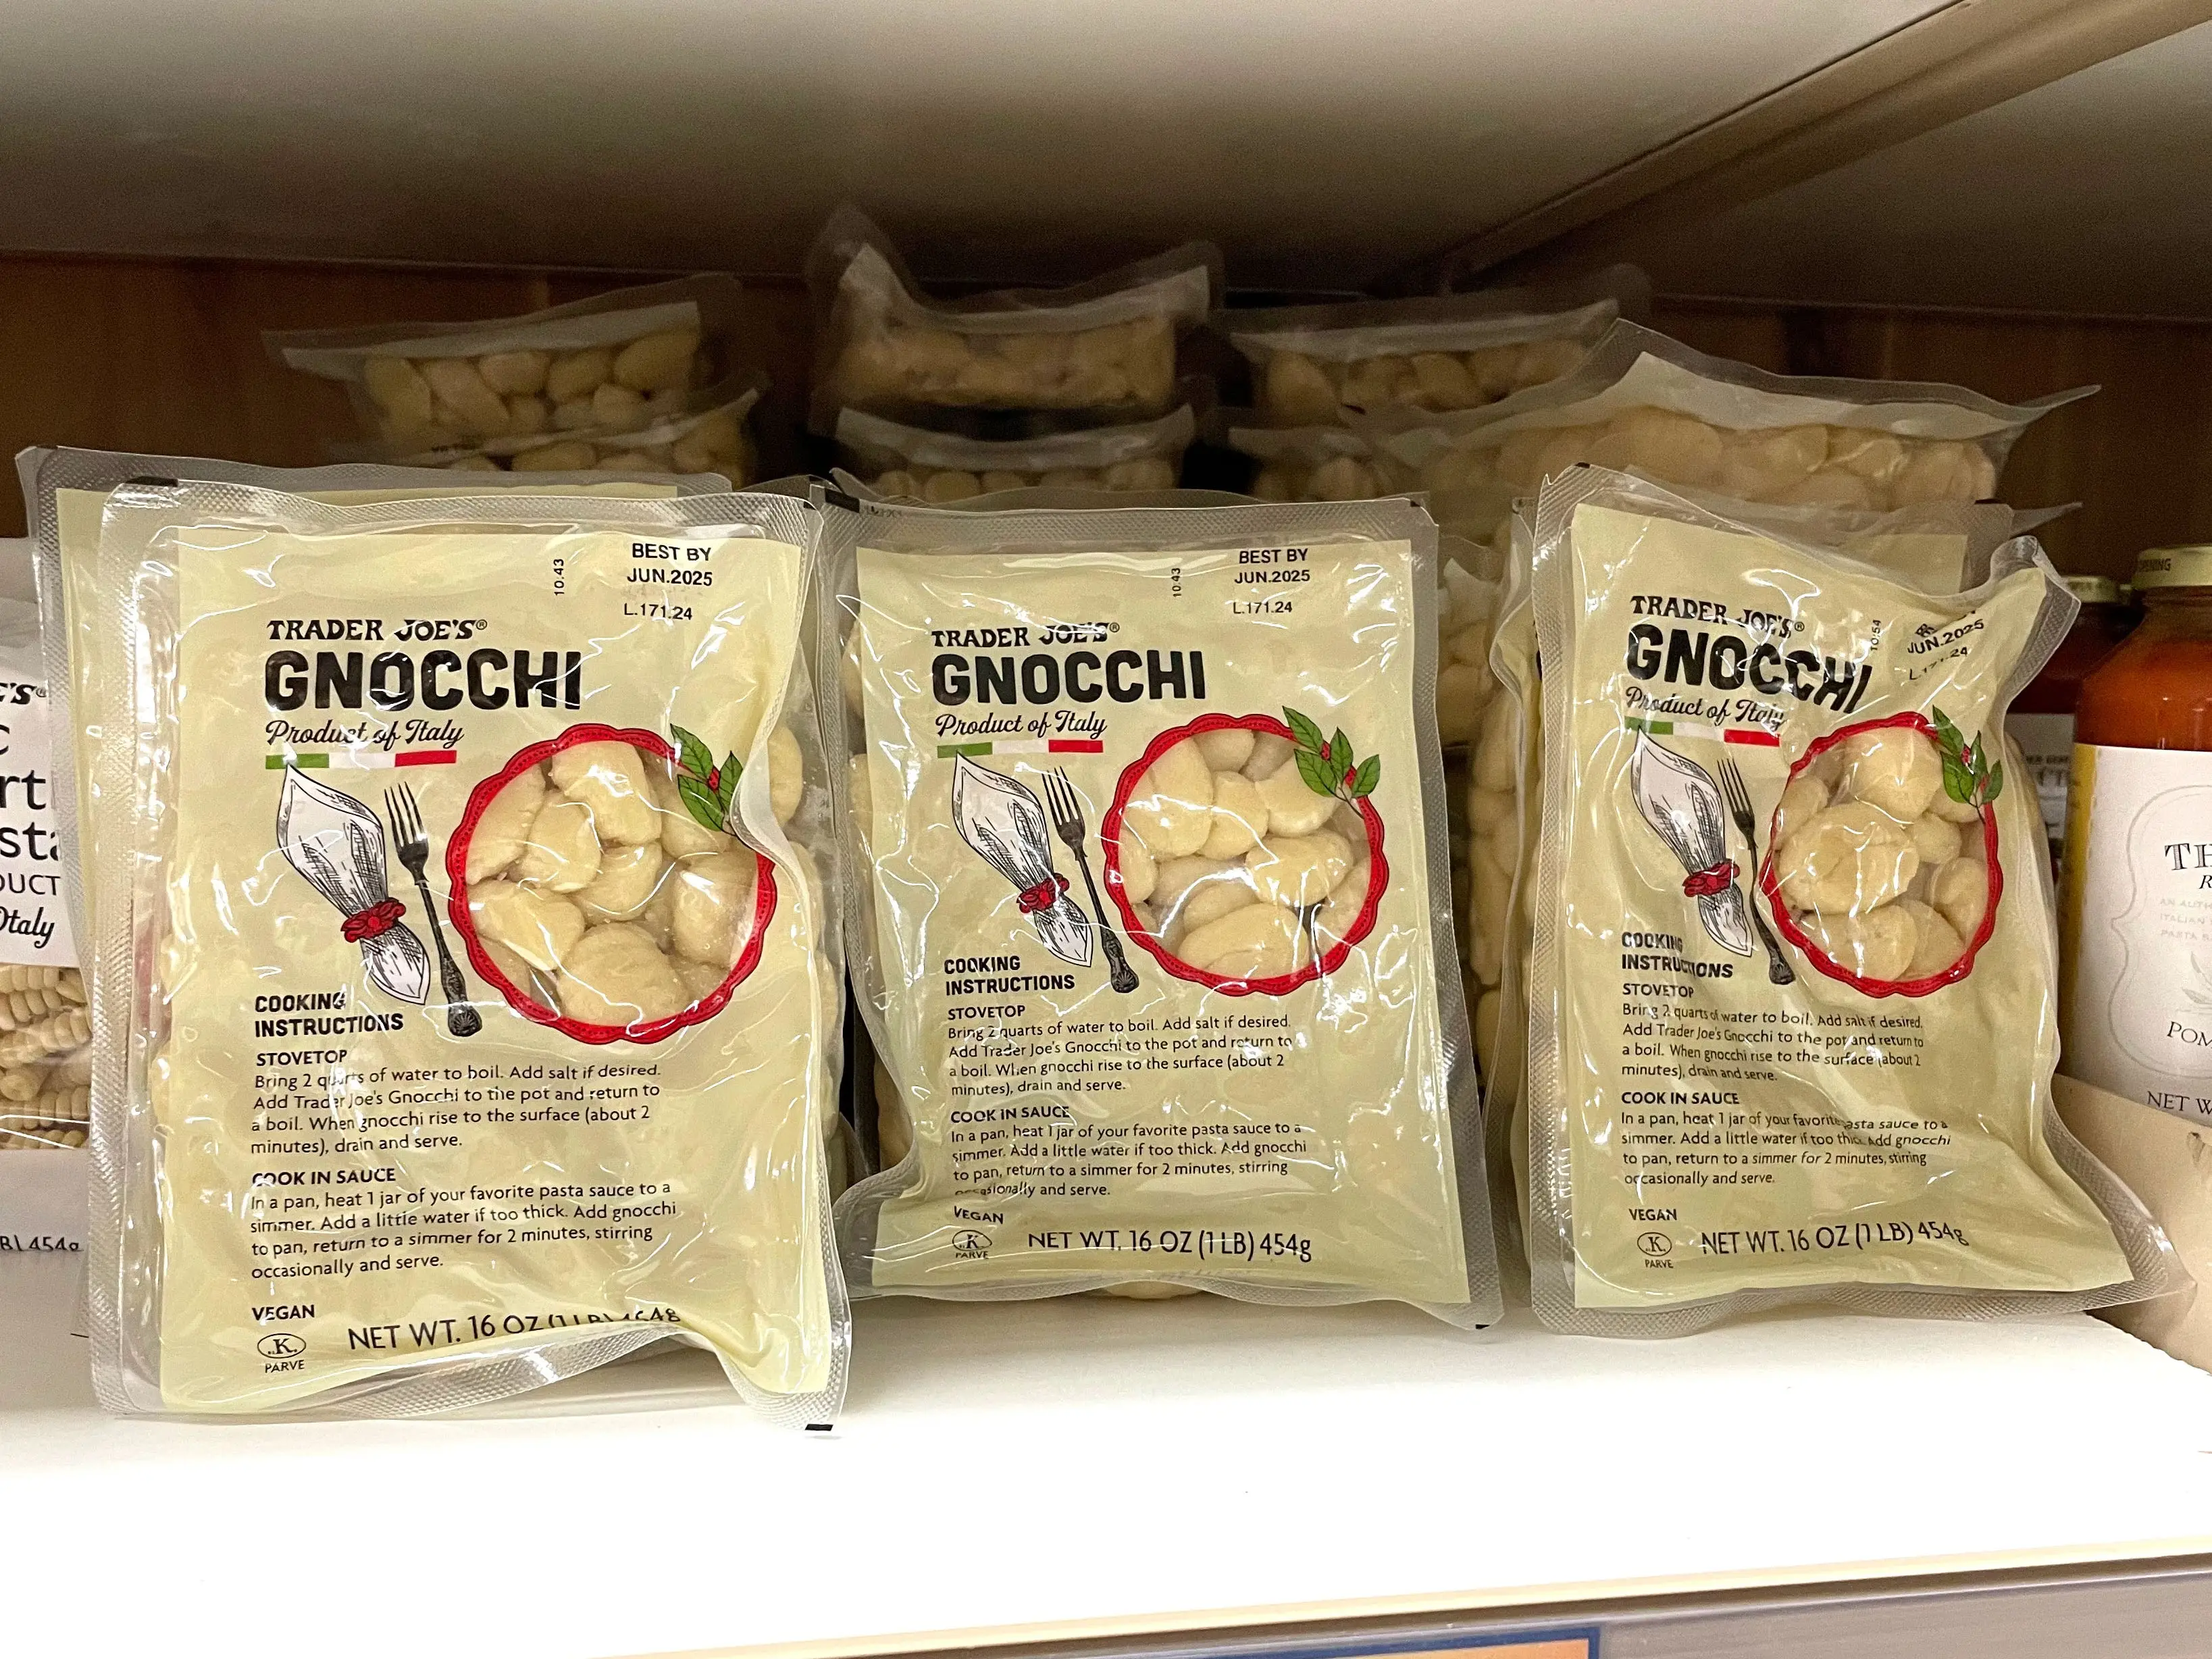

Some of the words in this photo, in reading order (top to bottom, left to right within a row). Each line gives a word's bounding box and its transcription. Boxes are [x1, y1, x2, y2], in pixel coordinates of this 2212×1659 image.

[632, 543, 680, 560] BEST
[686, 547, 711, 561] BY
[1239, 550, 1281, 564] BEST
[1287, 548, 1309, 562] BY
[627, 568, 713, 586] JUN.2025
[1234, 569, 1310, 584] JUN.2025
[623, 603, 692, 620] L.171.24
[1233, 601, 1293, 615] L.171.24
[1630, 595, 1728, 626] TRADER
[267, 619, 384, 641] TRADER
[931, 626, 1031, 648] TRADER
[1907, 619, 1984, 653] JUN.2025
[932, 649, 1206, 706] GNOCCHI
[1626, 623, 1873, 714] GNOCCHI
[265, 648, 581, 711] GNOCCHI
[1626, 686, 1703, 716] Product
[1706, 699, 1730, 725] of
[935, 711, 1023, 737] Product
[1028, 712, 1051, 737] of
[1054, 710, 1108, 737] Italy
[265, 719, 367, 745] Product
[373, 720, 401, 751] of
[405, 719, 465, 749] Italy
[1622, 932, 1682, 953] COOKING
[944, 955, 1021, 975] COOKING
[1622, 954, 1734, 978] INSTRUCTIONS
[946, 975, 1075, 996] INSTRUCTIONS
[1622, 983, 1694, 999] STOVETOP
[255, 992, 346, 1013] COOKING
[948, 1005, 1025, 1020] STOVETOP
[255, 1013, 404, 1038] INSTRUCTIONS
[948, 1027, 983, 1041] Bring
[988, 1026, 996, 1038] 2
[1000, 1024, 1042, 1039] quarts
[1048, 1021, 1062, 1034] of
[1067, 1022, 1104, 1033] water
[1109, 1021, 1124, 1032] to
[1128, 1019, 1159, 1031] boil.
[1162, 1017, 1191, 1030] Add
[1195, 1017, 1219, 1029] salt
[1224, 1015, 1235, 1028] if
[1238, 1014, 1291, 1028] desired.
[257, 1050, 347, 1067] STOVETOP
[1622, 1092, 1666, 1104] COOK
[1670, 1092, 1687, 1104] IN
[1691, 1092, 1740, 1104] SAUCE
[2147, 1090, 2190, 1111] NET
[252, 1119, 260, 1131] a
[267, 1117, 303, 1131] boil.
[309, 1115, 354, 1131] When
[360, 1111, 423, 1132] gnocchi
[430, 1111, 457, 1125] rise
[464, 1109, 481, 1123] to
[487, 1108, 514, 1122] the
[520, 1107, 580, 1121] surface
[586, 1106, 636, 1125] (about
[641, 1106, 650, 1119] 2
[951, 1109, 996, 1123] COOK
[1001, 1108, 1017, 1119] IN
[1021, 1106, 1070, 1118] SAUCE
[251, 1139, 329, 1156] minutes),
[335, 1138, 371, 1153] drain
[380, 1135, 409, 1149] and
[415, 1135, 462, 1148] serve.
[252, 1172, 305, 1187] COOK
[311, 1171, 330, 1184] IN
[336, 1169, 396, 1183] SAUCE
[1624, 1171, 1708, 1188] occasionally
[1712, 1171, 1738, 1184] and
[1741, 1174, 1775, 1185] serve.
[251, 1196, 264, 1209] In
[270, 1198, 278, 1209] a
[284, 1198, 319, 1213] pan,
[325, 1192, 362, 1206] heat
[367, 1192, 374, 1205] 1
[380, 1193, 401, 1208] jar
[407, 1188, 424, 1203] of
[430, 1191, 465, 1206] your
[471, 1185, 534, 1200] favorite
[540, 1185, 583, 1200] pasta
[589, 1185, 634, 1196] sauce
[640, 1183, 657, 1194] to
[663, 1183, 671, 1193] a
[251, 1219, 315, 1233] simmer.
[320, 1215, 355, 1230] Add
[362, 1218, 370, 1228] a
[377, 1213, 417, 1227] little
[423, 1209, 470, 1224] water
[475, 1208, 484, 1221] if
[491, 1208, 518, 1220] too
[523, 1204, 568, 1219] thick.
[574, 1204, 607, 1217] Add
[613, 1201, 675, 1221] gnocchi
[954, 1206, 1004, 1224] VEGAN
[1628, 1208, 1677, 1221] VEGAN
[252, 1242, 268, 1255] to
[274, 1242, 307, 1258] pan,
[313, 1237, 365, 1252] return
[371, 1235, 388, 1247] to
[394, 1237, 403, 1246] a
[409, 1233, 472, 1246] simmer
[478, 1229, 503, 1243] for
[507, 1229, 516, 1242] 2
[521, 1227, 590, 1242] minutes,
[595, 1225, 653, 1241] stirring
[1028, 1231, 1073, 1249] NET
[1079, 1229, 1122, 1251] WT.
[1129, 1230, 1152, 1252] 16
[1160, 1230, 1193, 1253] OZ
[1198, 1229, 1213, 1260] (1
[1221, 1231, 1255, 1261] LB)
[1260, 1233, 1312, 1262] 454g
[1701, 1231, 1740, 1254] NET
[1746, 1230, 1784, 1254] WT.
[1788, 1229, 1810, 1251] 16
[1816, 1225, 1849, 1249] OZ
[1855, 1223, 1871, 1250] (1
[1878, 1221, 1913, 1245] LB)
[1918, 1221, 1969, 1246] 454g
[955, 1251, 988, 1260] PARVE
[1645, 1259, 1674, 1269] PARVE
[252, 1259, 353, 1279] occasionally
[360, 1254, 390, 1271] and
[396, 1256, 443, 1269] serve.
[252, 1304, 315, 1321] VEGAN
[348, 1325, 401, 1350] NET
[409, 1319, 461, 1346] WT.
[468, 1315, 496, 1339] 16
[503, 1315, 544, 1335] OZ
[265, 1360, 305, 1373] PARVE
